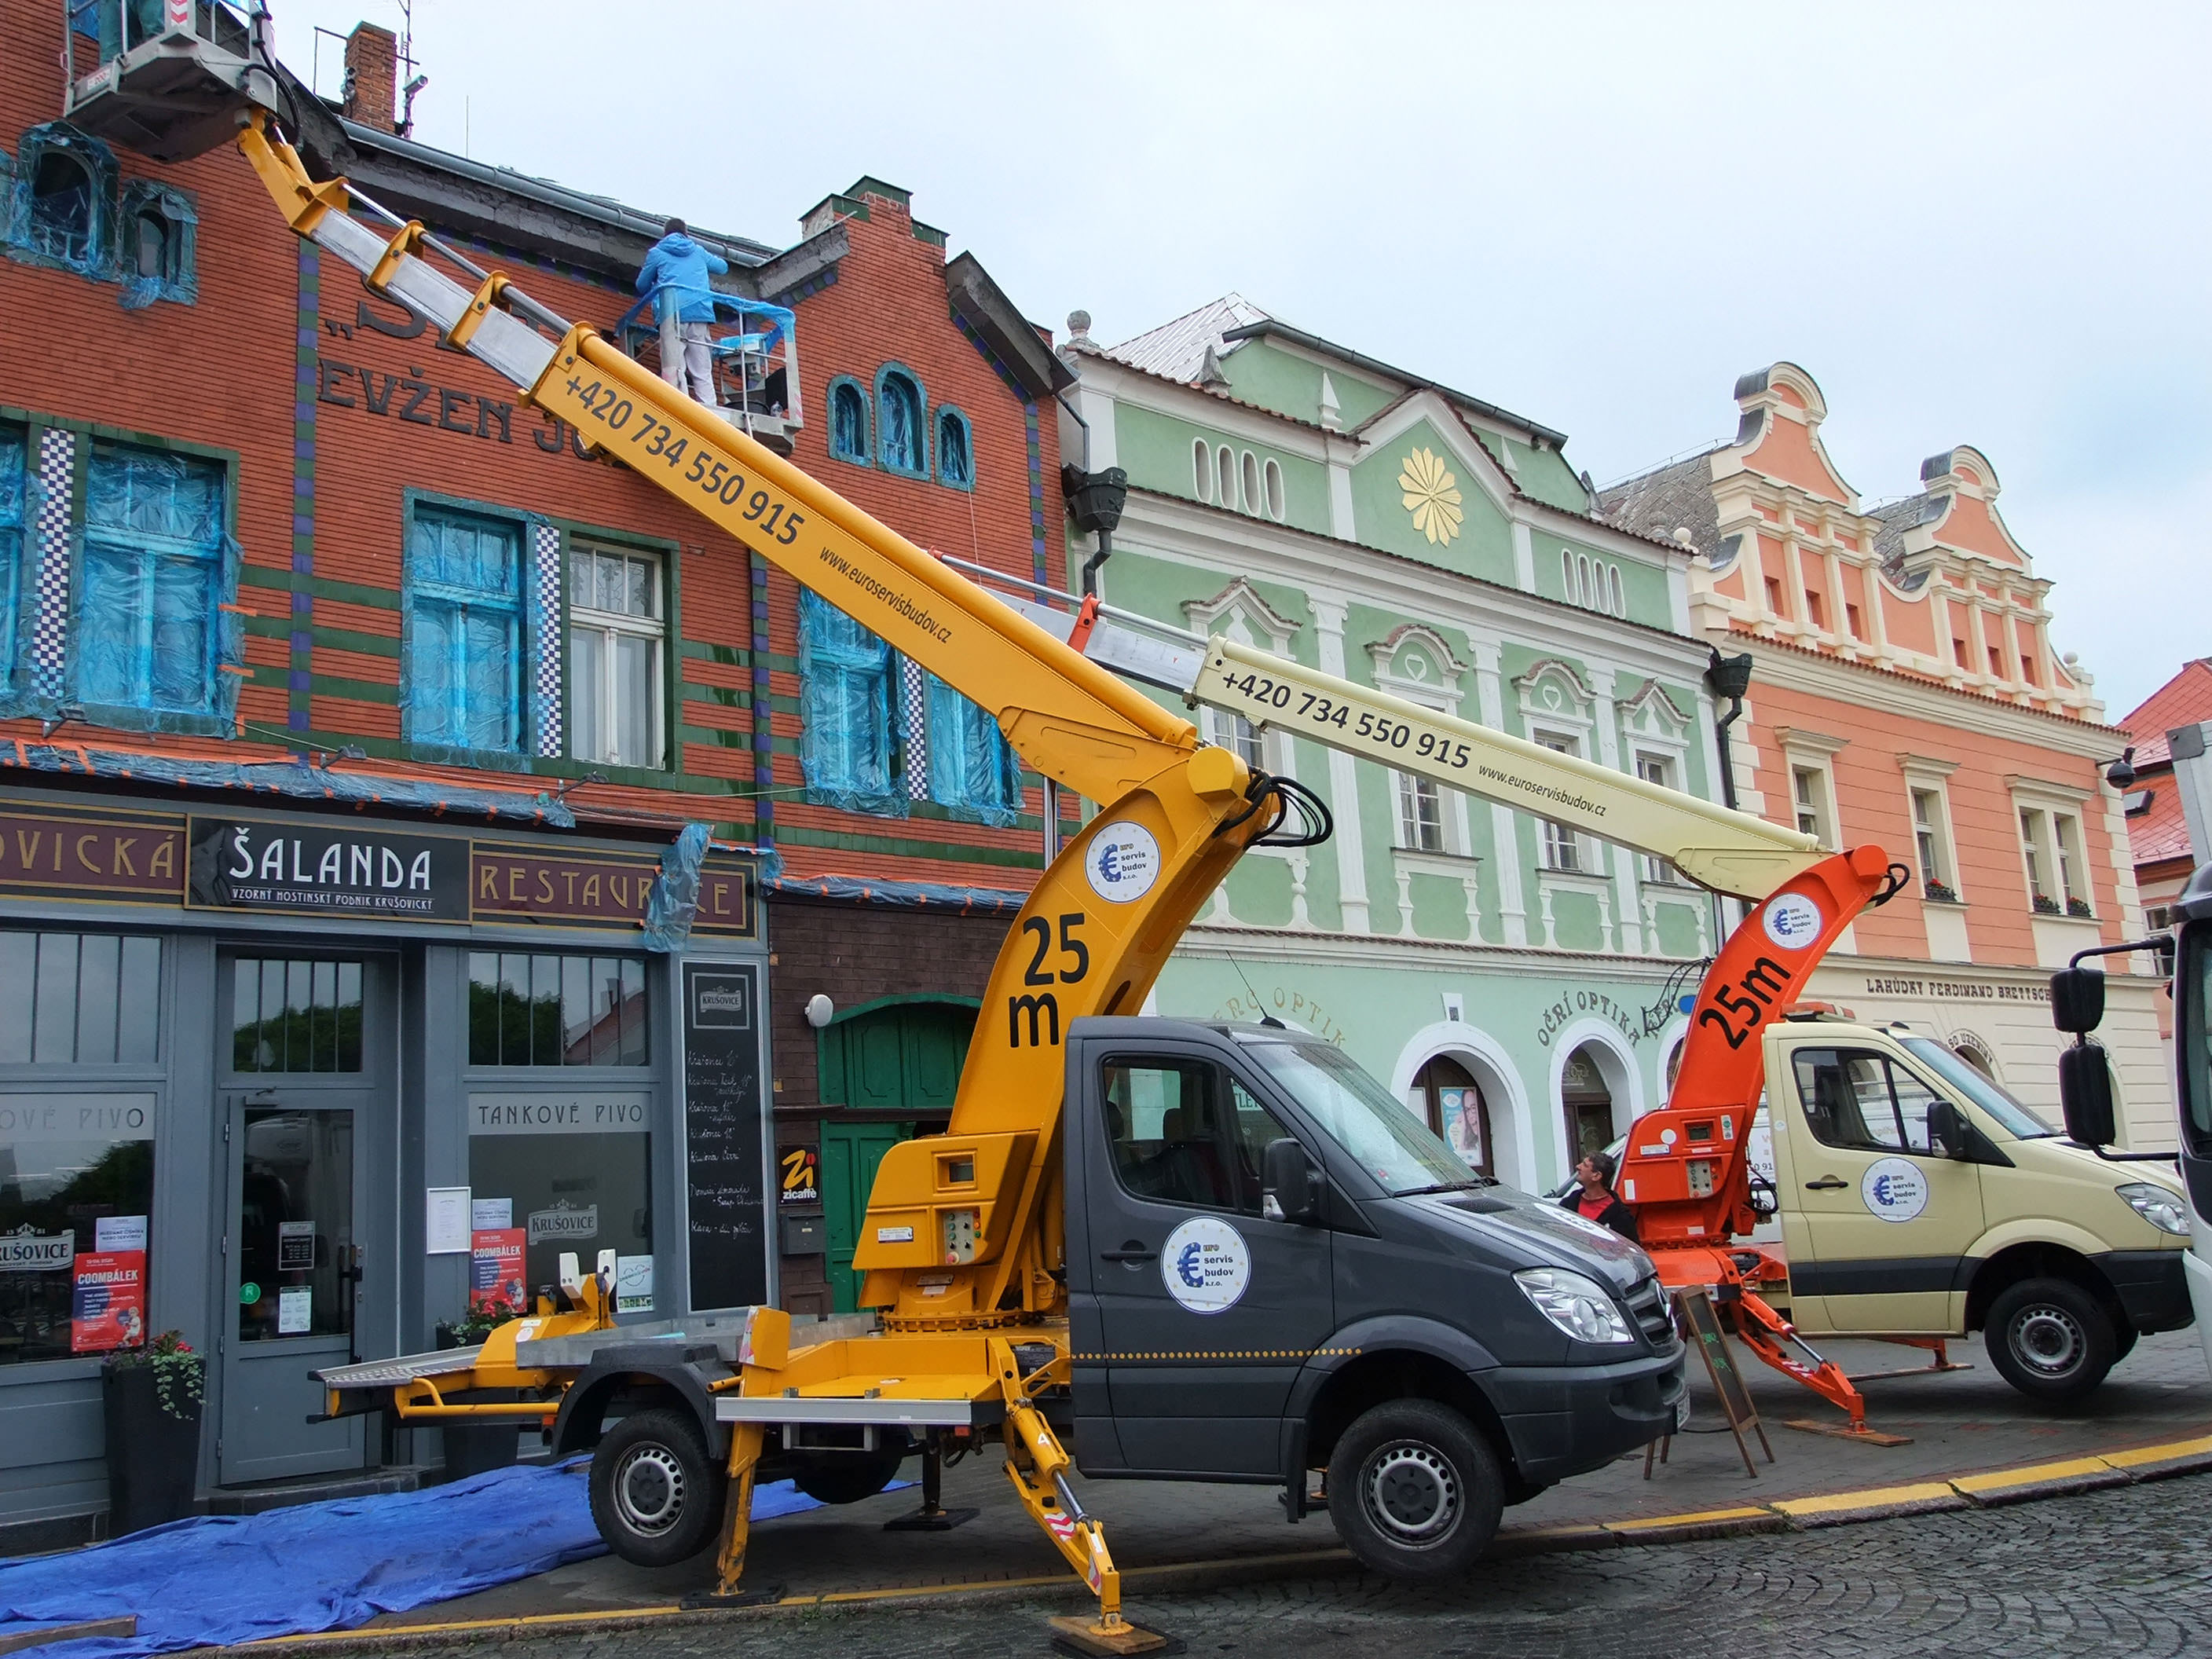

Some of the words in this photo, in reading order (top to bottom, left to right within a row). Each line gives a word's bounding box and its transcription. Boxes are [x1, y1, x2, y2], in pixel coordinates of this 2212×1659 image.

[319, 358, 513, 444] EVŽEN
[566, 375, 633, 430] +420
[631, 413, 689, 467] 734
[685, 452, 745, 505] 550
[742, 491, 805, 544] 915
[819, 546, 953, 644] www.euroservisbudov.cz
[1221, 672, 1291, 709] +420
[1296, 691, 1349, 729] 734
[1354, 712, 1411, 749] 550
[1415, 732, 1472, 769] 915
[1478, 764, 1608, 817] www.euroservisbudov.cz
[229, 827, 431, 891] ŠALANDA
[1121, 851, 1146, 862] servis
[1122, 862, 1147, 872] budov
[232, 887, 273, 900] VZORNÝ
[276, 890, 331, 904] HOSTINSKÝ
[335, 895, 372, 906] PODNIK
[375, 896, 433, 910] KRUŠOVICKÝ
[480, 865, 731, 915] RESTAURE
[1023, 913, 1090, 987] 25
[1928, 981, 1994, 998] FERDINAND
[1009, 992, 1060, 1048] m
[1577, 991, 1641, 1049] OPTIKA
[79, 1108, 145, 1129] PIVO
[478, 1101, 580, 1125] TANKOVÉ
[595, 1104, 643, 1123] PIVO
[782, 1188, 817, 1199] zicaffè
[532, 1214, 595, 1232] KRUŠOVICE
[474, 1244, 522, 1258] COOMBÁLEK
[1204, 1255, 1233, 1264] servis
[78, 1269, 138, 1285] COOMBÁLEK
[1205, 1268, 1234, 1276] budov
[1037, 1432, 1051, 1445] 4
